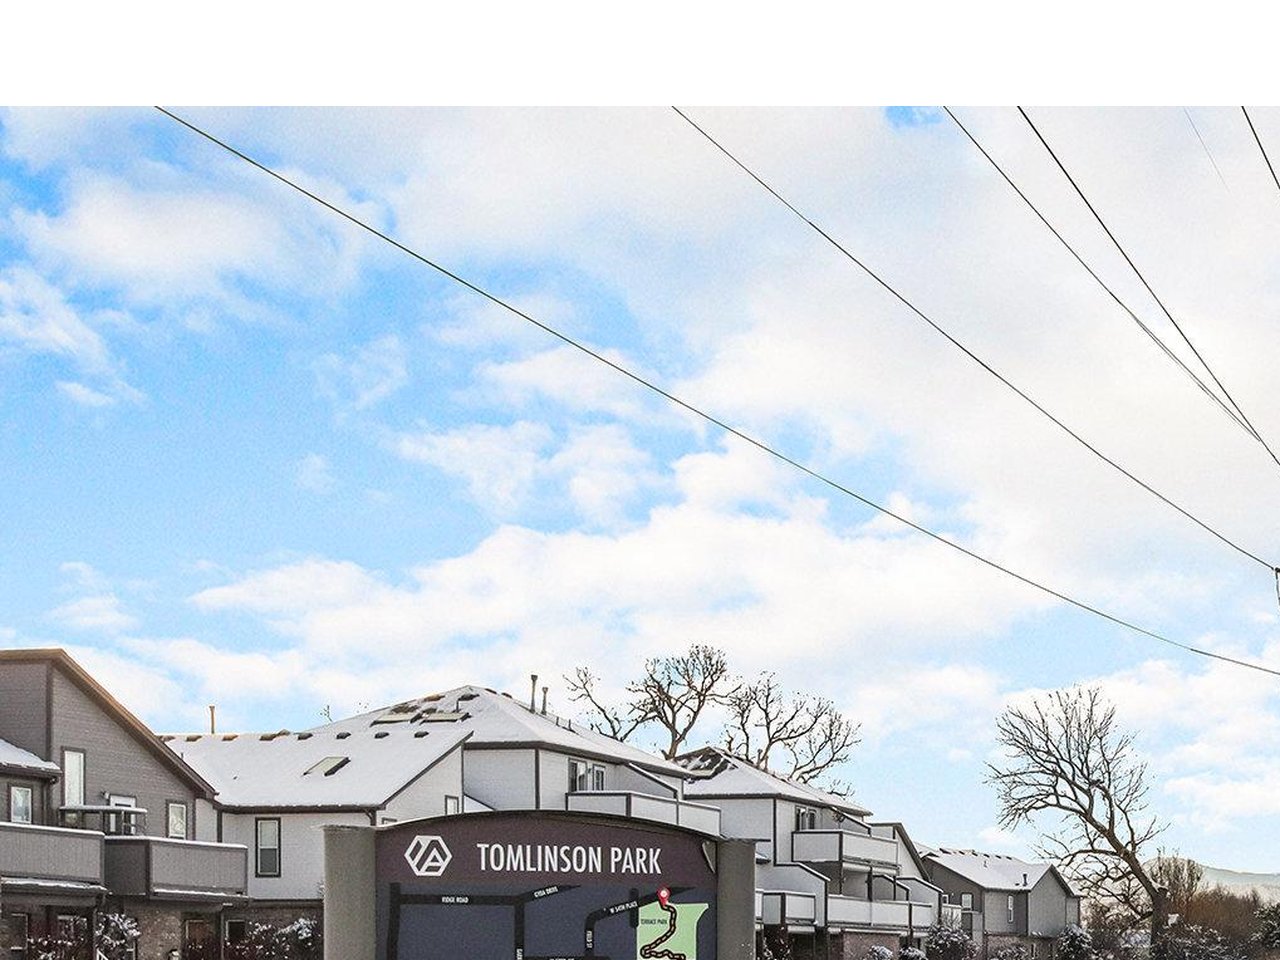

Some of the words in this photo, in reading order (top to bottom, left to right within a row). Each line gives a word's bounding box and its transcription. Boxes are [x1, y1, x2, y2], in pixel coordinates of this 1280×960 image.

[476, 843, 601, 873] TOMLINSON
[610, 847, 662, 874] PARK
[626, 901, 638, 910] PLACE
